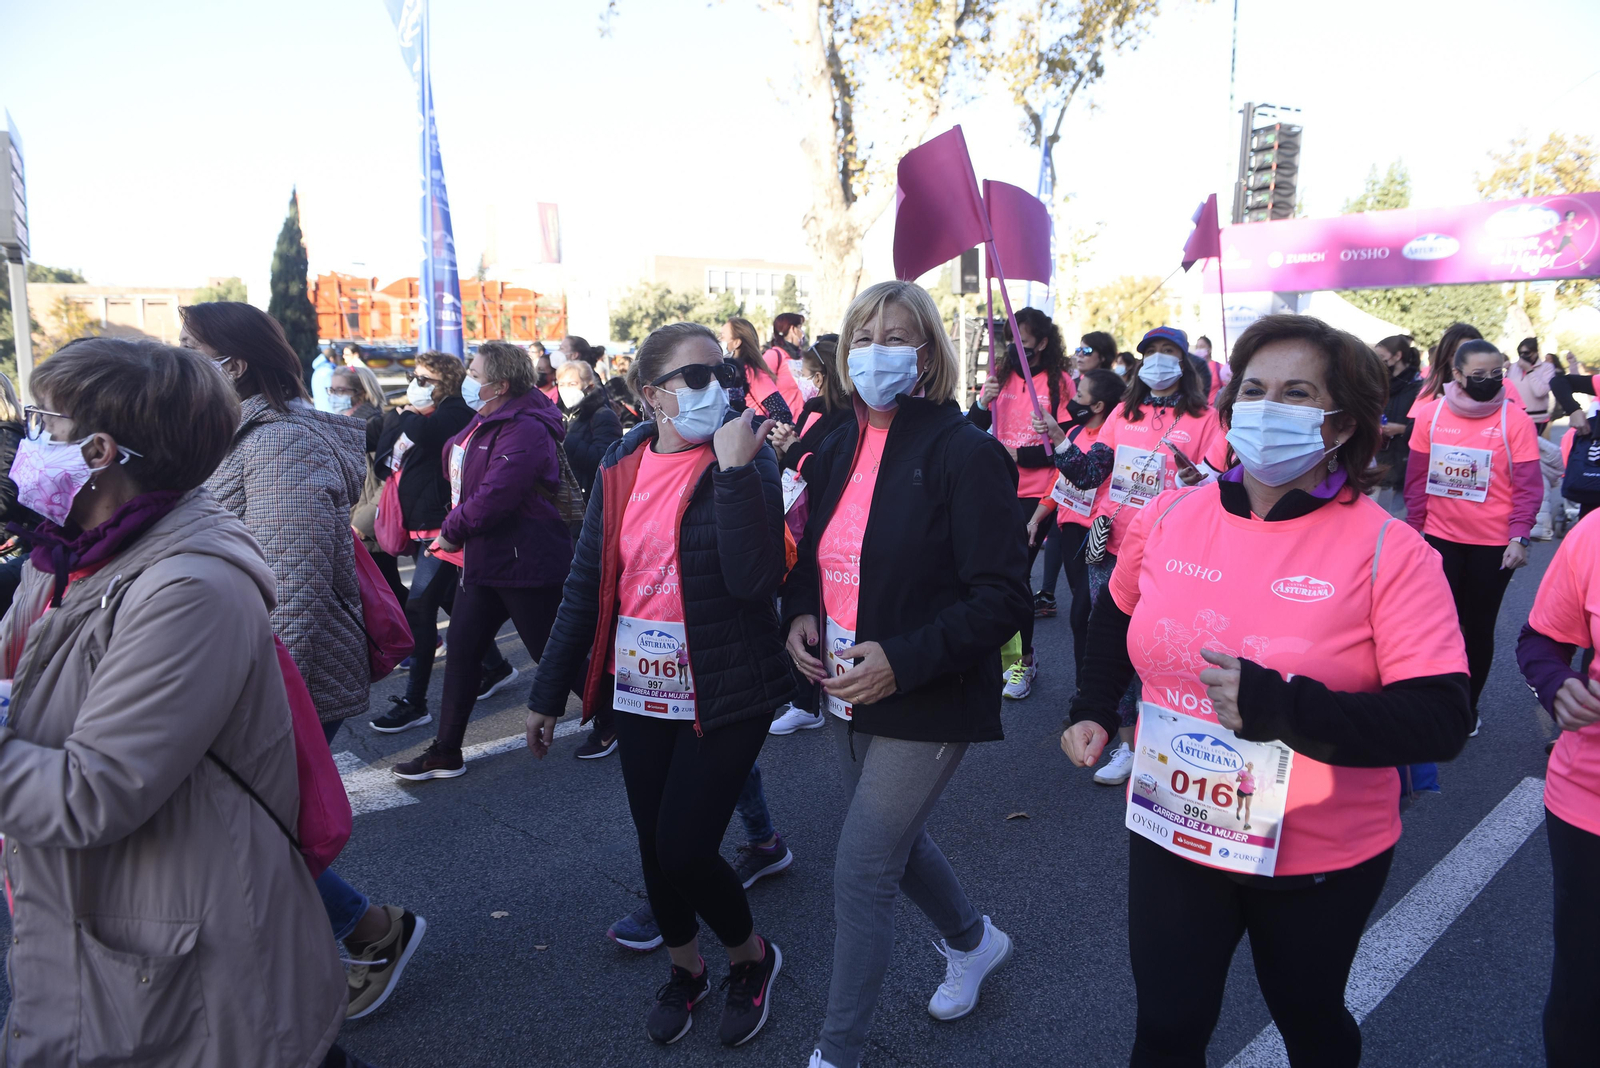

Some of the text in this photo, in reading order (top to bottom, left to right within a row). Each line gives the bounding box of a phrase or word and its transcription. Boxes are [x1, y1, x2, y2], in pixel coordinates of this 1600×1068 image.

[1286, 252, 1326, 264] ZURICH
[1340, 246, 1390, 262] OYSHO
[1124, 424, 1149, 433] OYSHO
[1131, 471, 1155, 486] 016
[1445, 466, 1470, 478] 016
[630, 491, 650, 502] HO
[1165, 558, 1223, 583] OYSHO
[637, 582, 679, 597] NOSOT
[1275, 581, 1330, 597] ASTURIANA
[640, 637, 676, 650] ASTURIANA
[638, 657, 677, 678] 016
[647, 680, 663, 690] 997
[629, 686, 651, 697] CARRERA
[668, 692, 690, 700] MUJER
[617, 696, 642, 709] OYSHO
[1175, 739, 1237, 770] ASTURIANA
[1171, 769, 1234, 808] 016
[1183, 803, 1208, 821] 996
[1132, 812, 1169, 839] OYSHO
[1152, 804, 1249, 844] CARRERA DE LA MUJER
[1183, 838, 1207, 851] Santander
[1233, 852, 1265, 865] ZURICH
